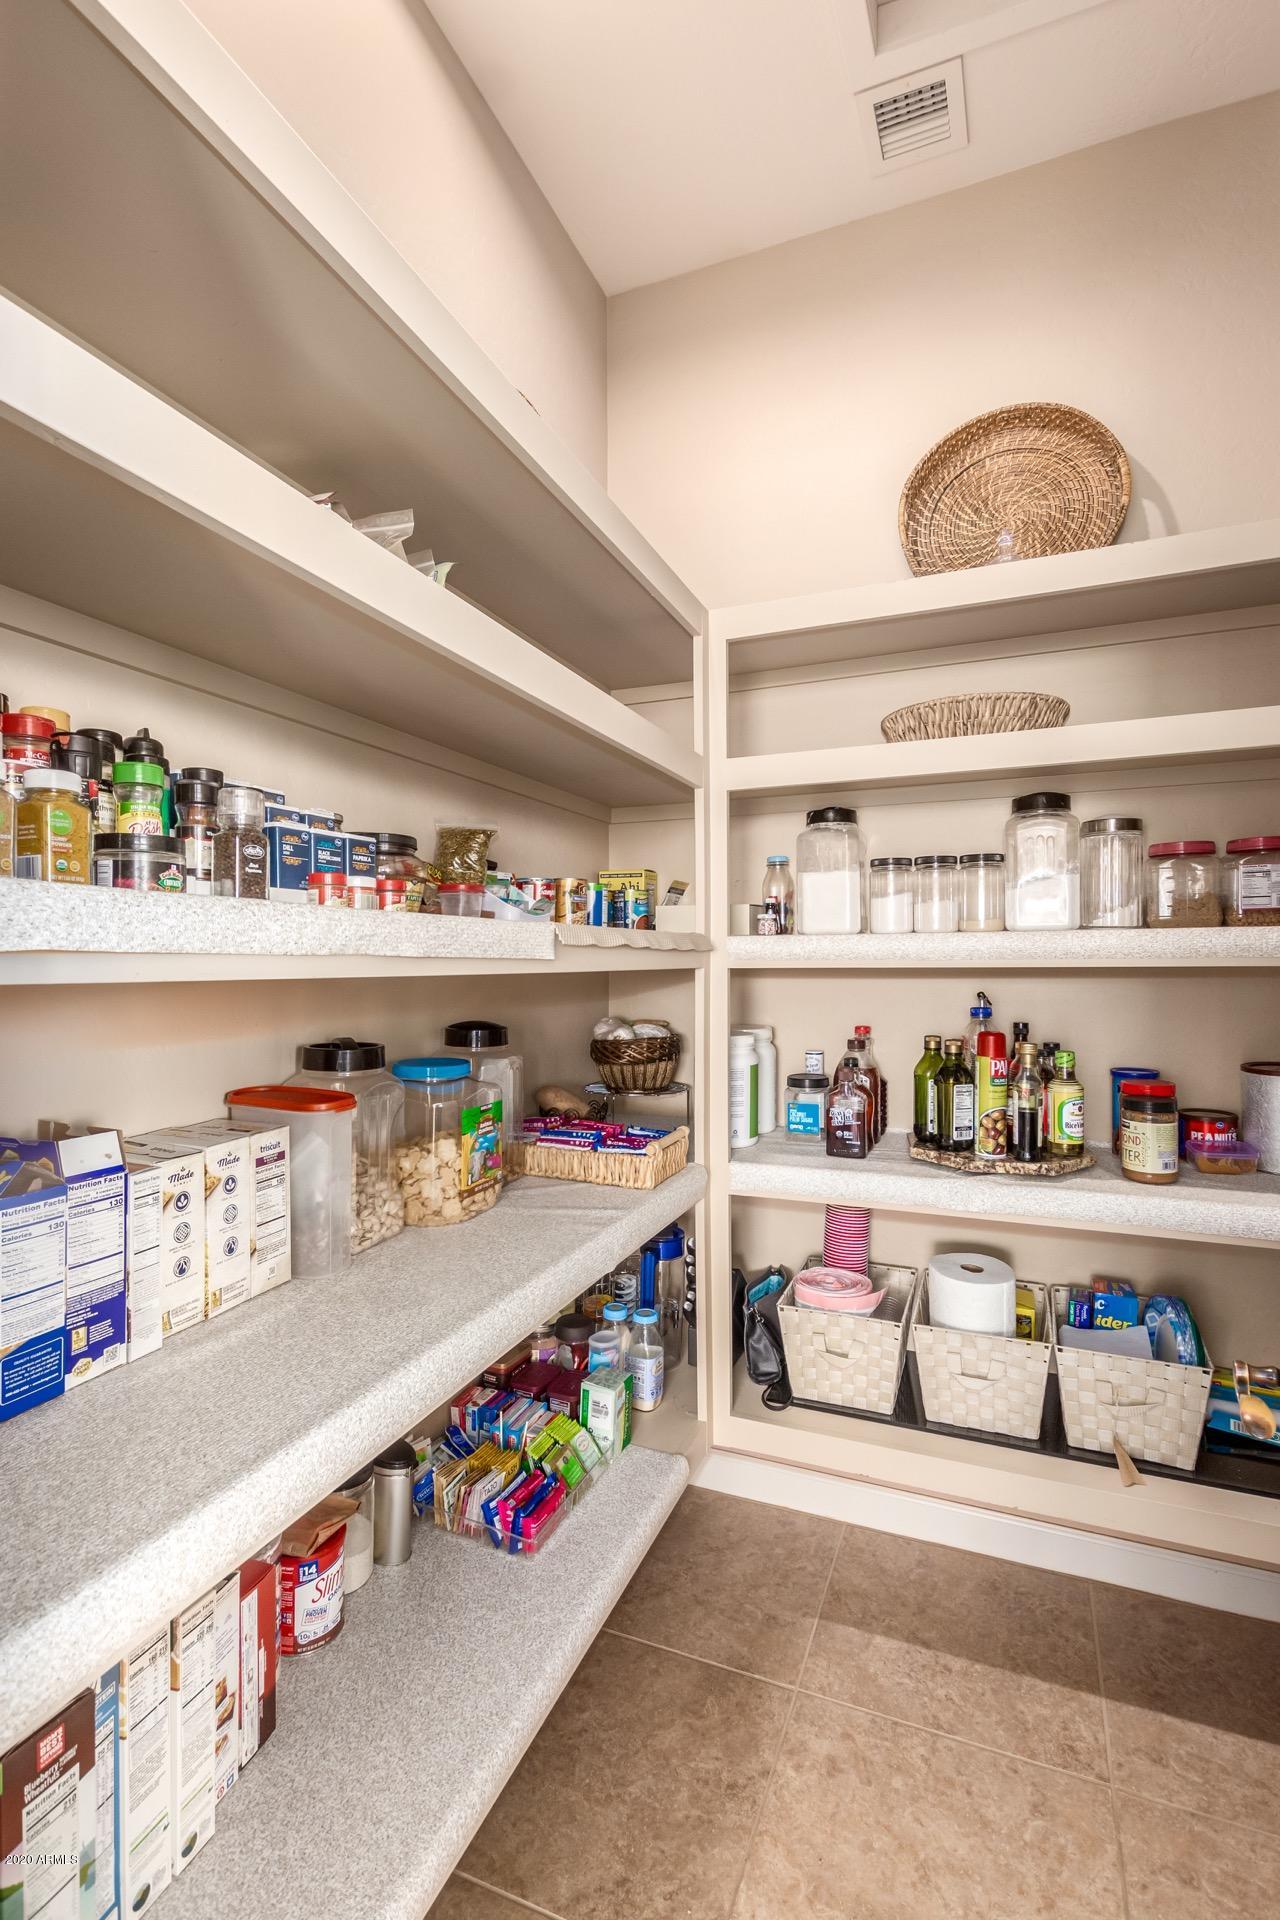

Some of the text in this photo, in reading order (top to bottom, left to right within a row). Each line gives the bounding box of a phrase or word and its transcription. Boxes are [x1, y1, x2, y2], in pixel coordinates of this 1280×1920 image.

[282, 844, 294, 852] DILL
[352, 854, 372, 863] PAPRIKA
[1190, 1131, 1237, 1143] PEANUTS
[260, 1141, 281, 1153] triscuit
[217, 1155, 241, 1168] Made
[168, 1170, 195, 1184] Made
[68, 1175, 123, 1192] Nutrition Facts
[1, 1199, 65, 1218] Nutrition Facts
[109, 1198, 124, 1207] 130
[68, 1208, 95, 1218] Calories
[48, 1221, 65, 1231] 130
[1, 1232, 32, 1244] Calories
[303, 1564, 318, 1577] 14
[24, 1762, 59, 1796] Blueberry
[26, 1772, 76, 1817] Nutrition Facts
